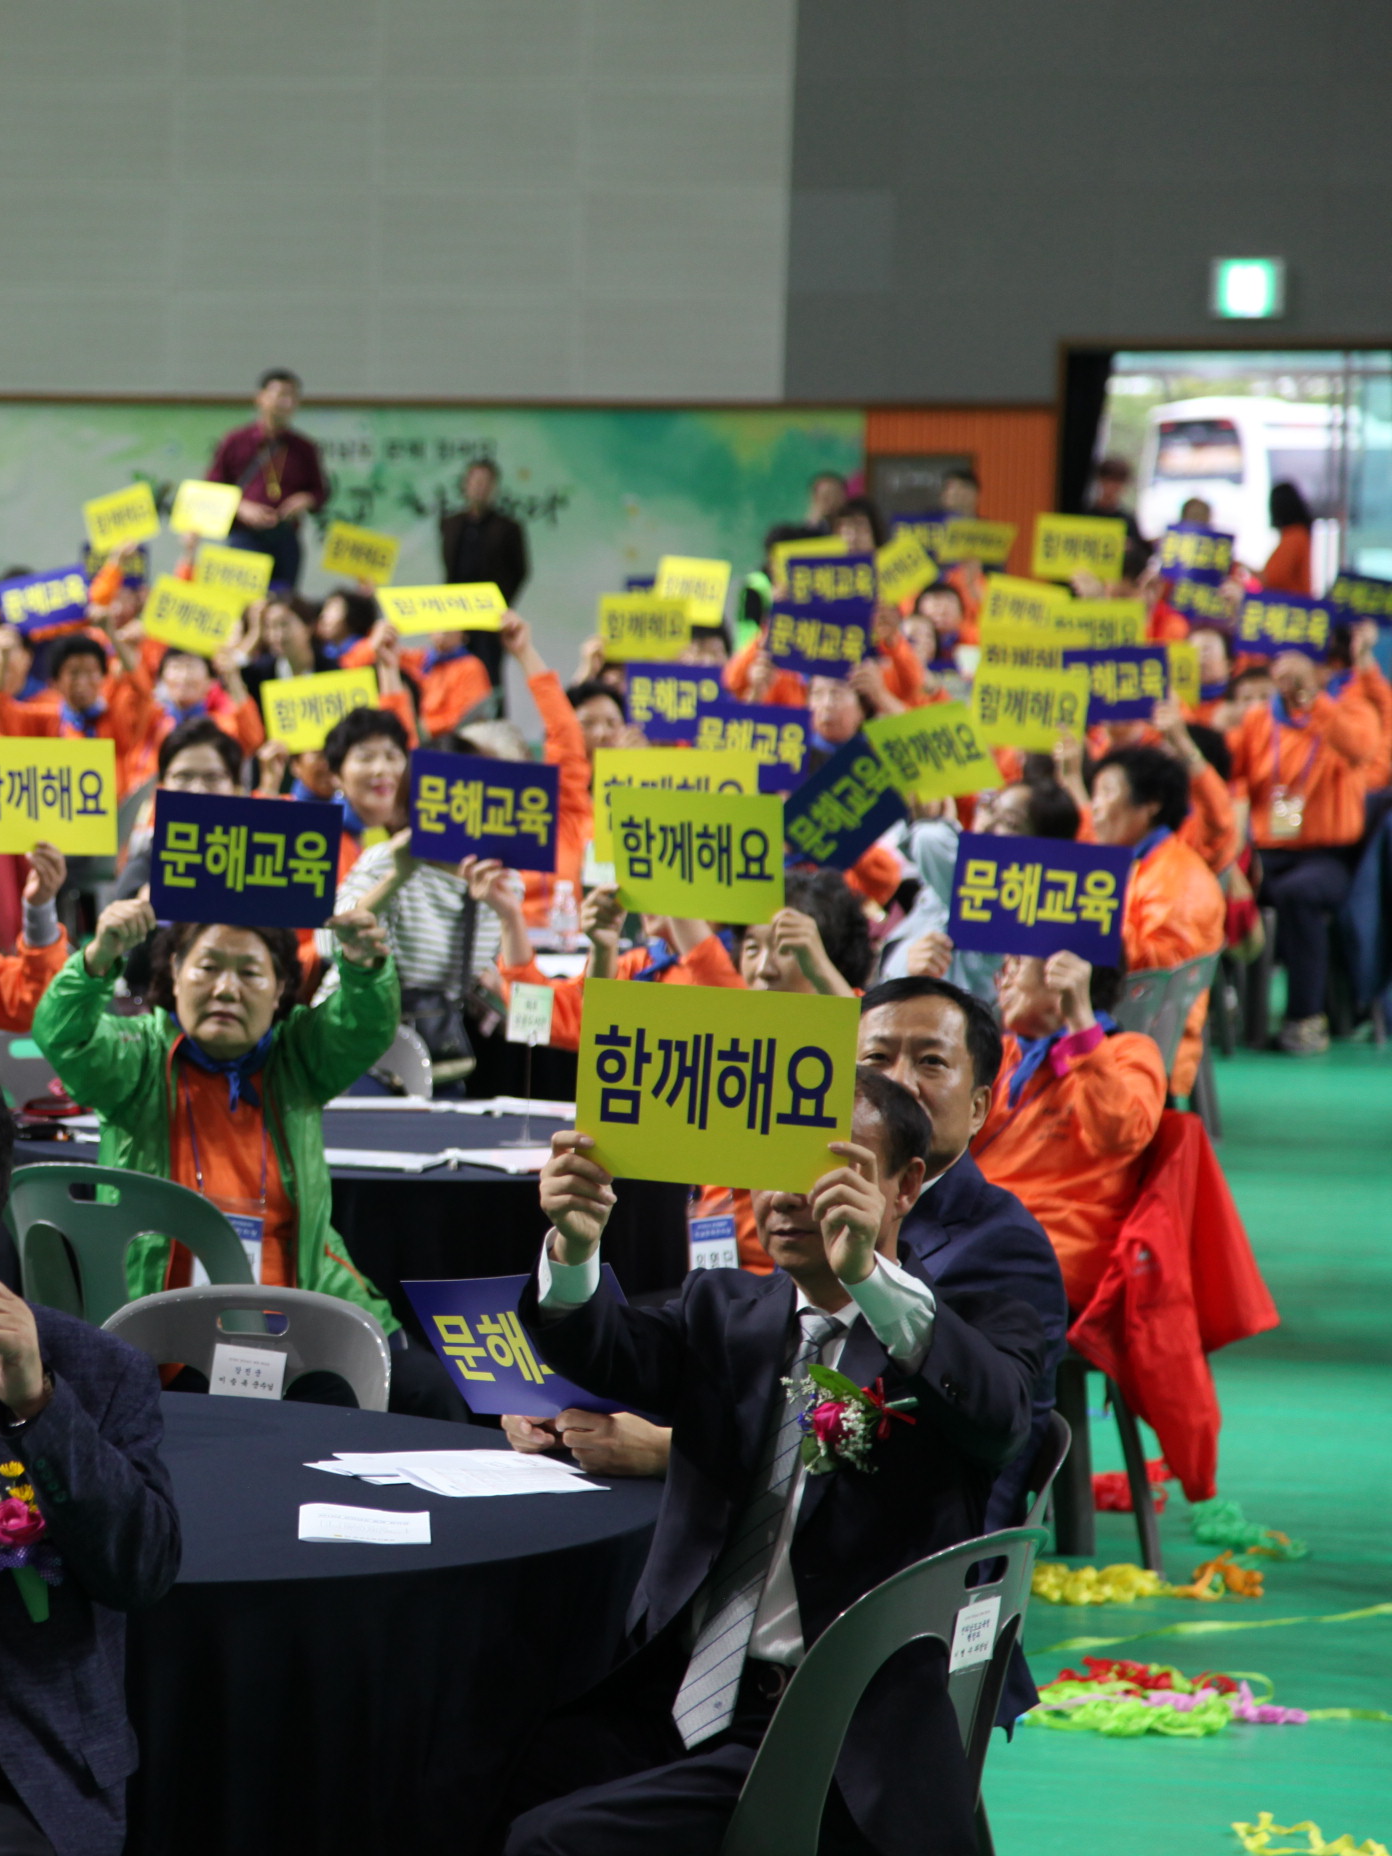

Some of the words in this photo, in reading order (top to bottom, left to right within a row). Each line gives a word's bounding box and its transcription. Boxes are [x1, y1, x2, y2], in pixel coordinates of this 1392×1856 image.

[979, 681, 1078, 727] 함께해요
[883, 722, 986, 781] 함께해요
[414, 775, 556, 846] 문해교육
[159, 820, 332, 899] 문해교육
[620, 815, 775, 888] 함께해요
[958, 858, 1119, 937] 문해교육
[594, 1025, 838, 1136] 함께해요
[432, 1310, 555, 1386] 문해
